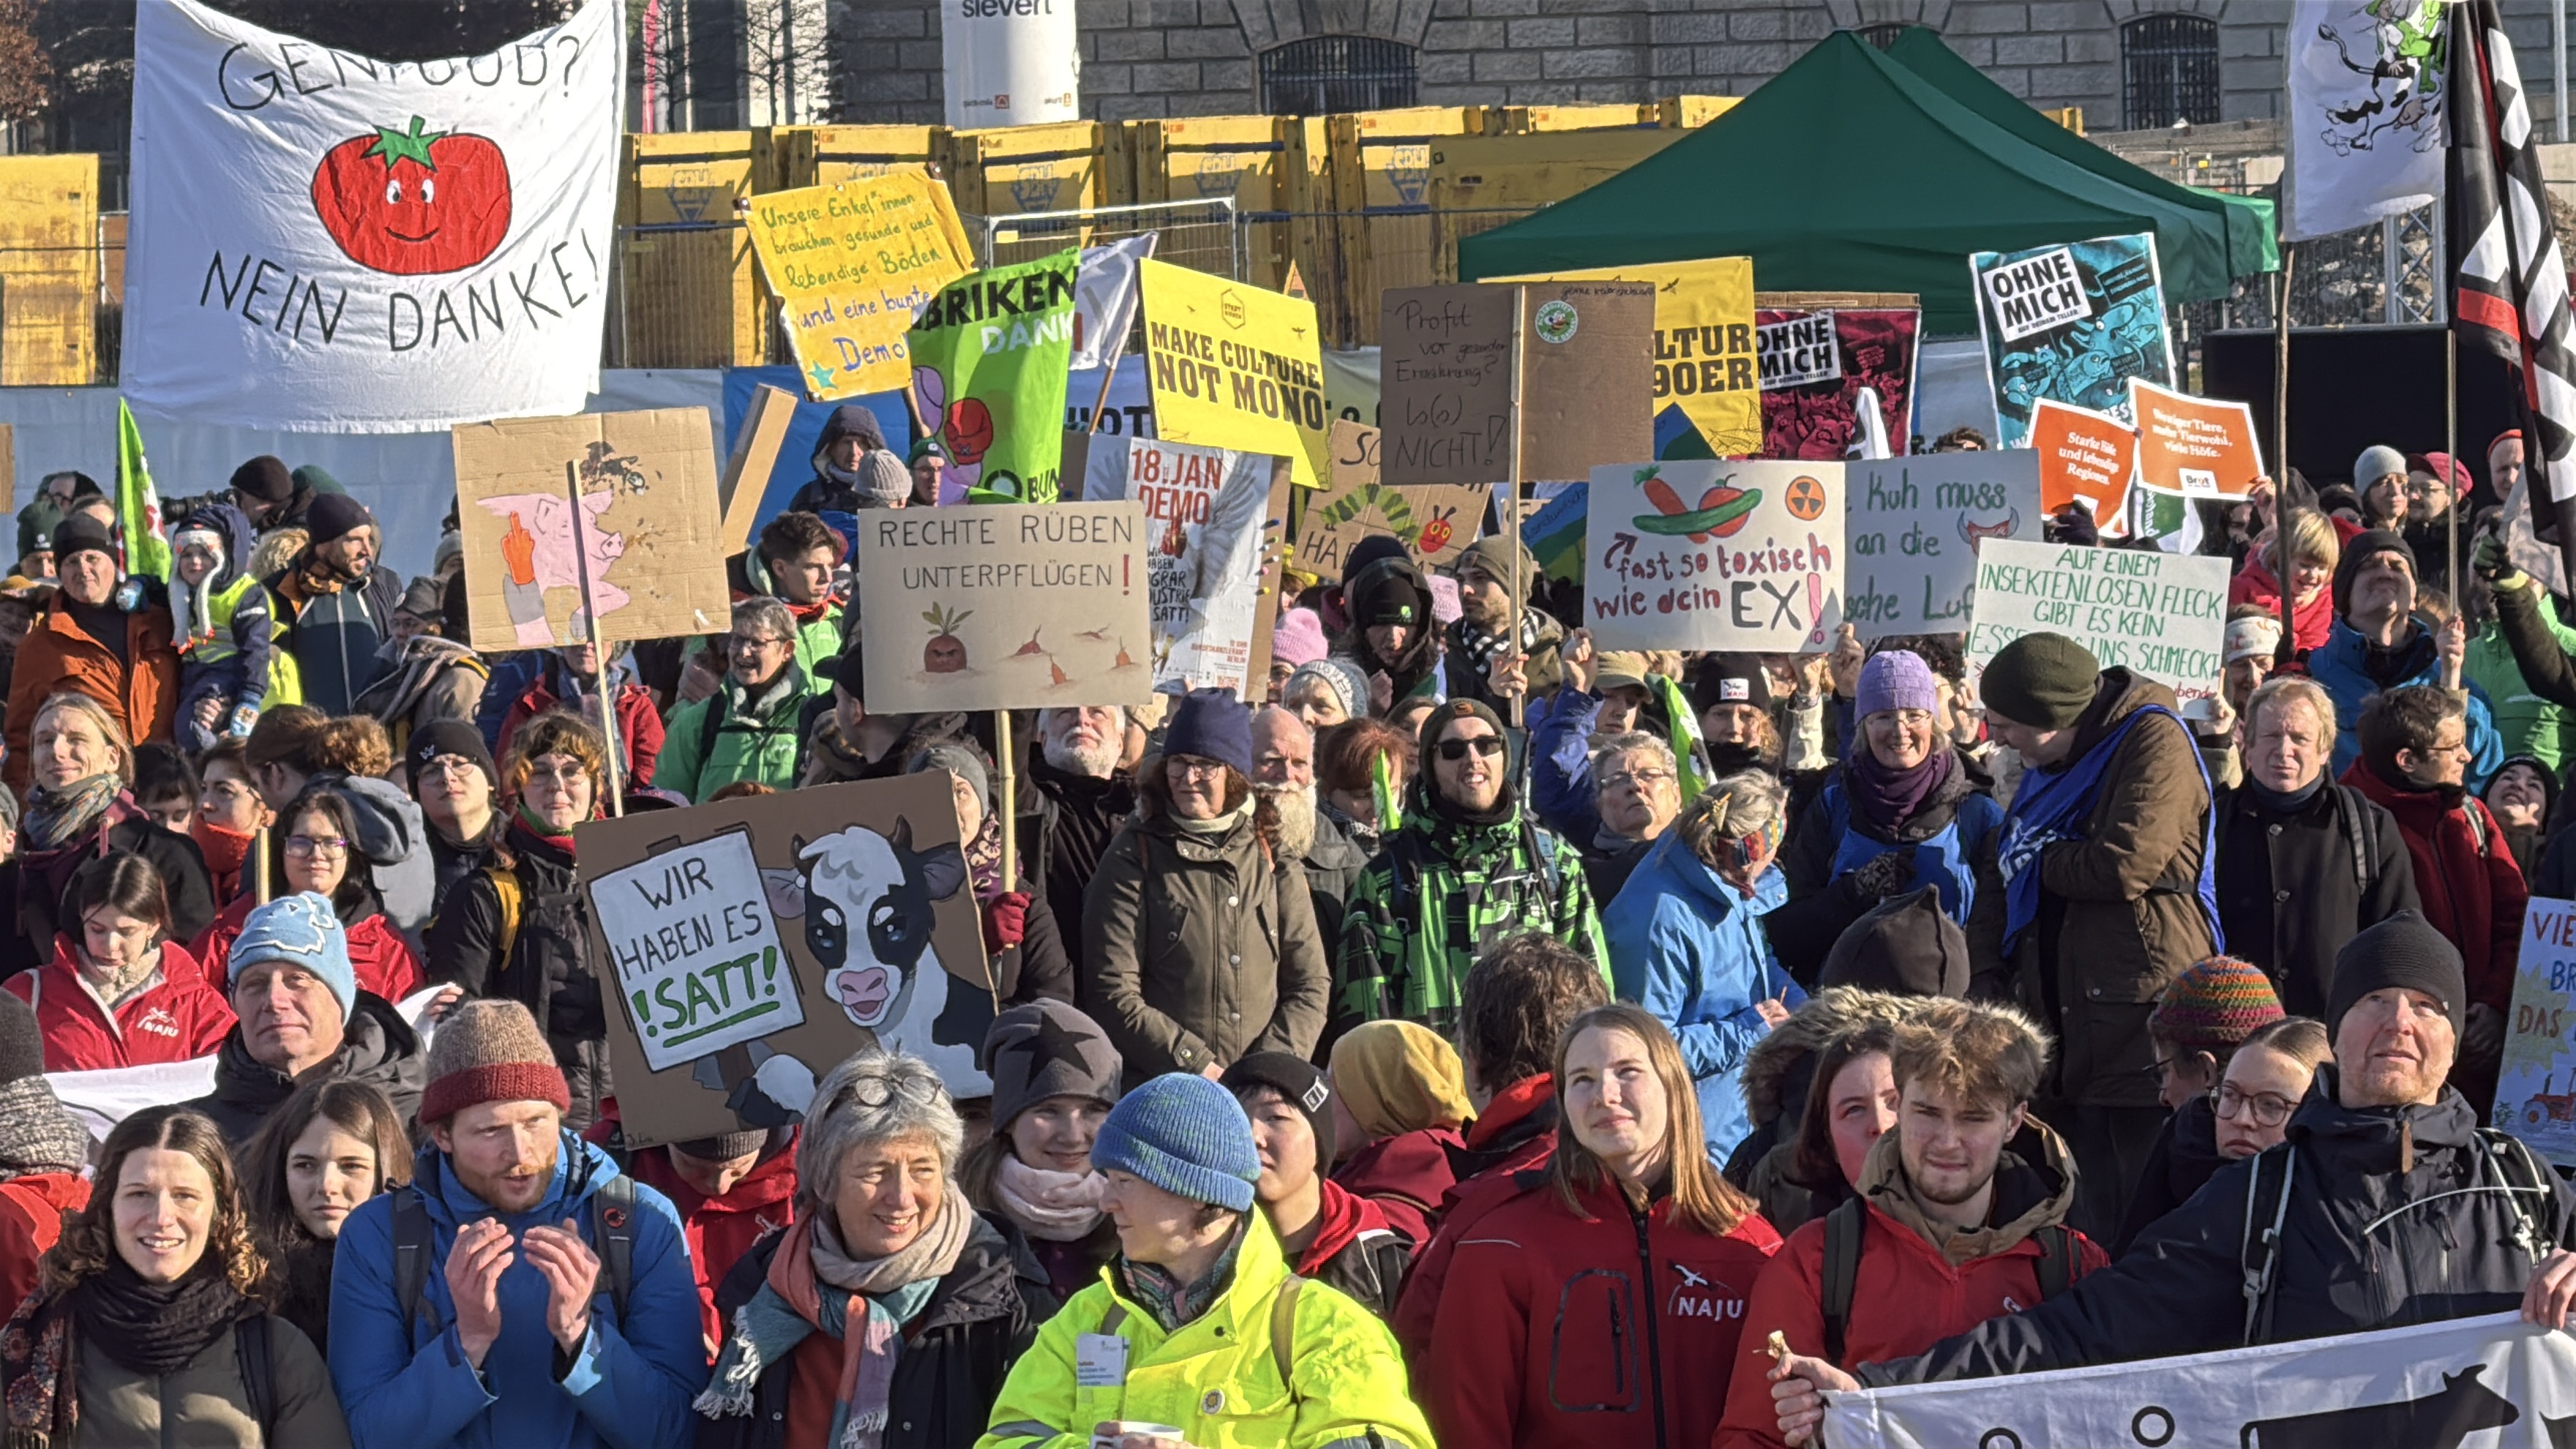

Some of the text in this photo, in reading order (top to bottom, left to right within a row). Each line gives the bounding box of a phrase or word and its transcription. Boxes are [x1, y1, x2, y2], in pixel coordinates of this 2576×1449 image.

[761, 207, 821, 229] Unsere
[774, 213, 934, 255] brauchen gesunde und
[785, 247, 942, 289] lebendige Böden
[1992, 252, 2072, 298] OHNE
[200, 229, 599, 351] NEIN DANKE!
[799, 285, 930, 329] und eine bunte
[2001, 280, 2081, 329] MICH
[1395, 299, 1472, 339] Profit
[1756, 318, 1830, 353] OHNE
[1151, 321, 1321, 390] MAKE CULTURE
[1419, 342, 1451, 355] vor
[1758, 345, 1833, 379] MICH
[1153, 351, 1221, 403] NOT
[1230, 371, 1325, 430] MONO
[1806, 370, 1828, 379] TELLER
[2059, 447, 2082, 461] und
[2068, 432, 2100, 449] Starke
[1138, 485, 1210, 525] DEMO
[1868, 468, 1918, 511] Kuh
[1936, 481, 2007, 511] muss
[880, 510, 1133, 547] RECHTE RÜBEN
[1855, 521, 1941, 556] an die
[1617, 532, 1832, 583] fast so toxisch
[2056, 547, 2161, 577] AUF EINEM
[1593, 585, 1647, 619] wie
[1657, 583, 1721, 614] dein
[1980, 564, 2224, 621] INSEKTENLOSEN FLECK
[1153, 606, 1189, 624] SATT!
[2033, 600, 2165, 638] GIBT ES KEIN
[2089, 637, 2128, 670] UNS
[2135, 643, 2220, 681] SCHMECKT
[632, 857, 714, 910] WIR
[615, 900, 763, 981] HABEN ES
[631, 946, 778, 1038] !SATT!
[2517, 1005, 2563, 1038] DAS
[1677, 1295, 1744, 1322] NAJU
